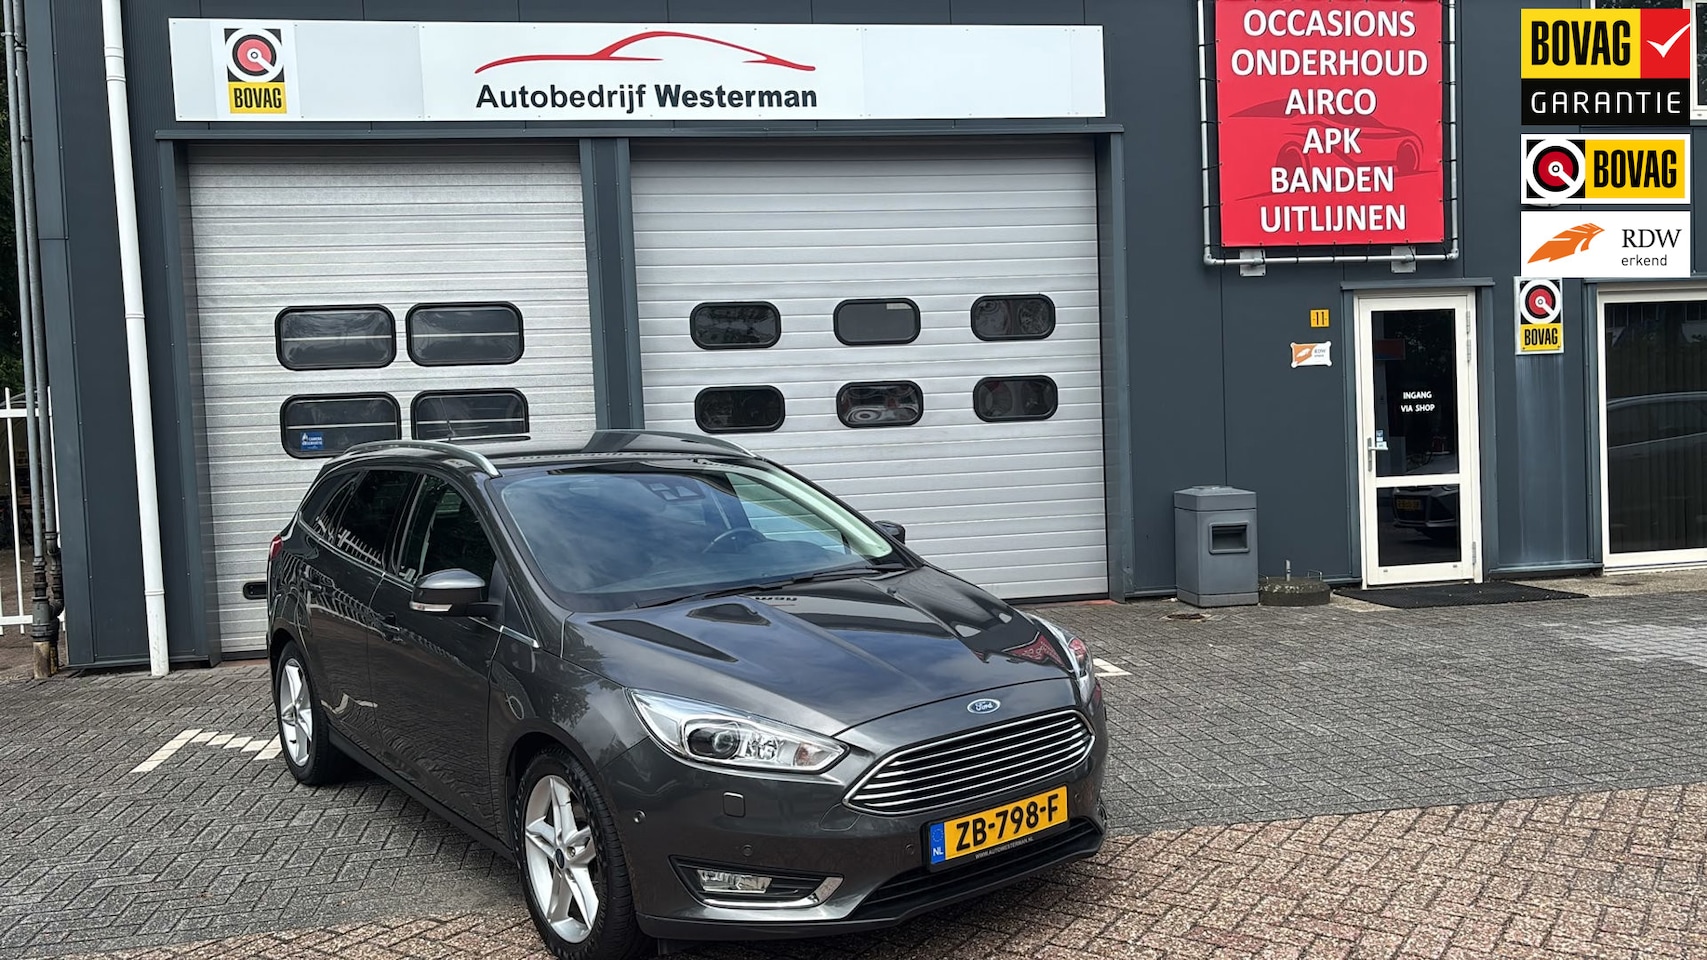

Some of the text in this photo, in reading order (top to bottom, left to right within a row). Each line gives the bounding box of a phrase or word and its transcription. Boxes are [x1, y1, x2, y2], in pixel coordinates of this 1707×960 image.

[1243, 9, 1416, 37] OCCASIONS
[1231, 49, 1428, 76] ONDERHOUD
[233, 87, 283, 111] BOVAG
[475, 84, 818, 115] Autobedrijf Westerman
[1285, 88, 1377, 115] AIRCO
[1303, 128, 1361, 153] APK
[1271, 167, 1394, 193] BANDEN
[1260, 204, 1406, 232] UITLIJNEN
[1316, 311, 1325, 326] 11
[1524, 328, 1558, 346] BOVAG
[1403, 391, 1432, 399] INGANG
[1415, 404, 1435, 412] SHOP
[974, 701, 993, 711] Ford
[956, 793, 1059, 852] ZB-798-F
[933, 847, 944, 856] NL
